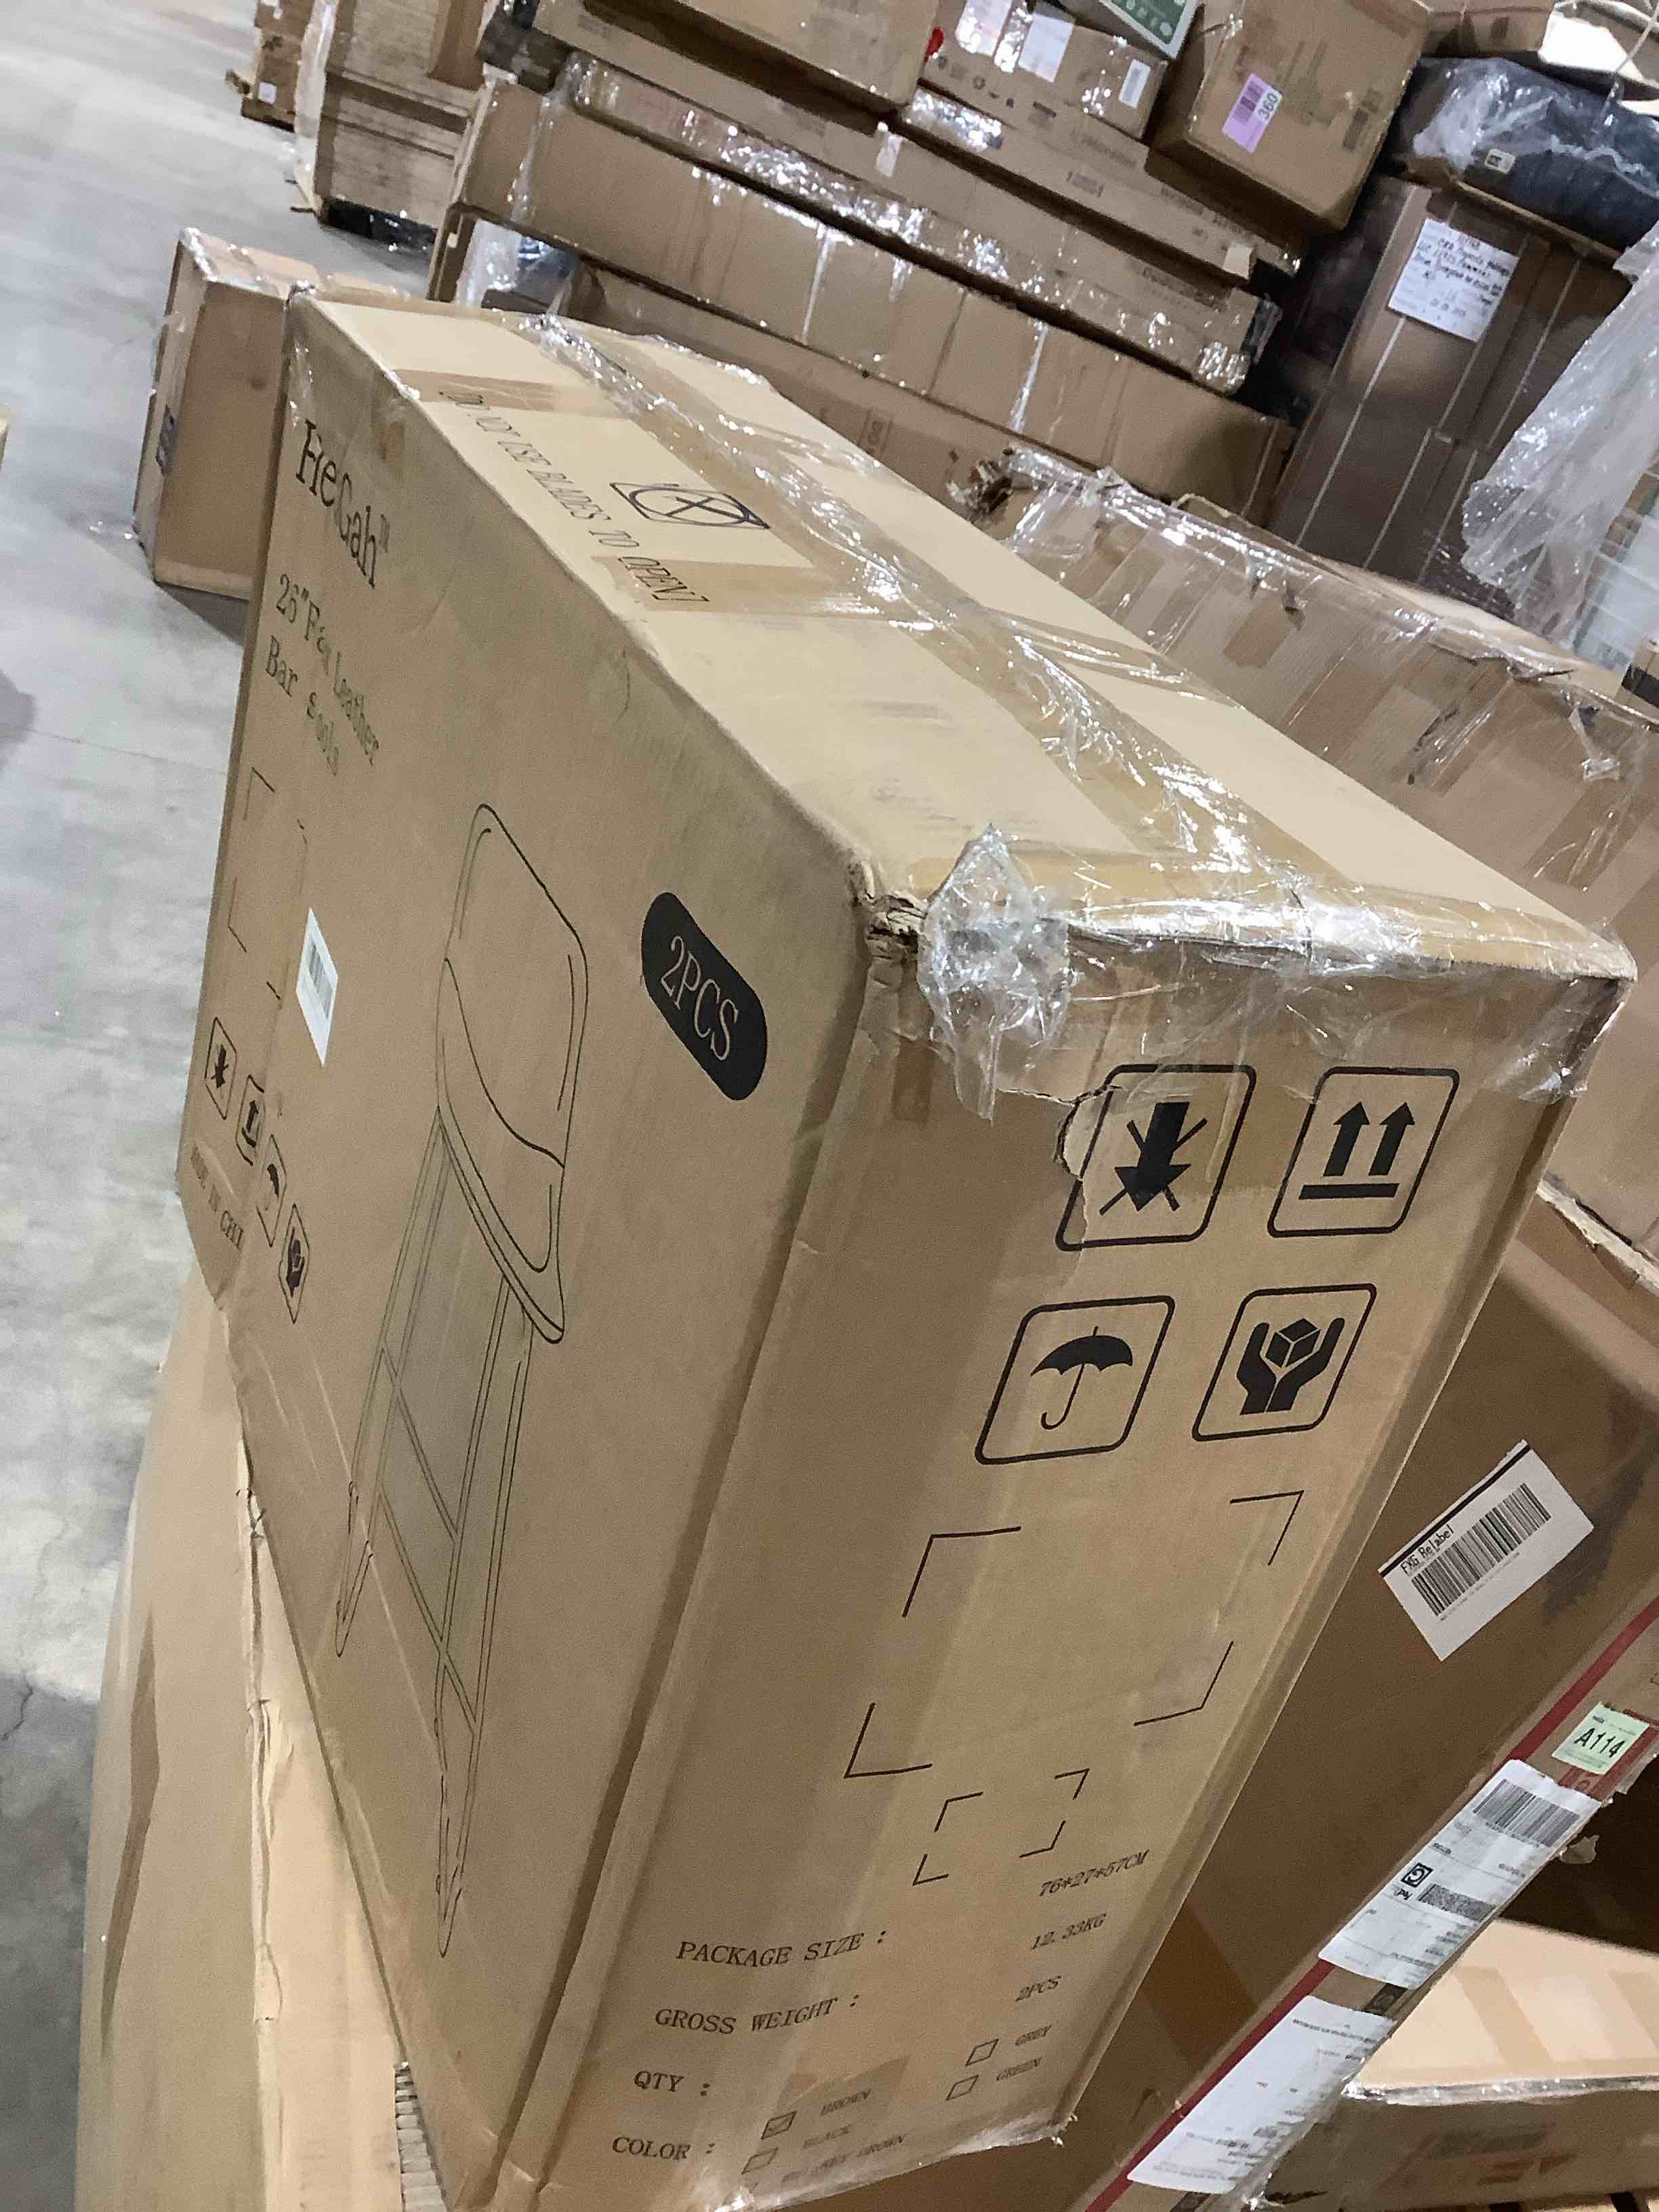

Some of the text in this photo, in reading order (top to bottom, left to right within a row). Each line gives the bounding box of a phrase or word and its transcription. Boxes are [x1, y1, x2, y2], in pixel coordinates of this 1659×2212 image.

[1258, 92, 1278, 120] 360
[497, 441, 551, 466] USE
[525, 468, 611, 520] BLADES
[588, 529, 639, 548] TO
[265, 635, 298, 698] Bar
[661, 936, 738, 1061] 2PCS
[1418, 1524, 1454, 1559] Relabel
[1574, 1727, 1626, 1758] A114
[676, 1941, 792, 1967] PACKAGE
[804, 1933, 864, 1961] SIZE
[634, 2071, 684, 2092] QTY
[1016, 1975, 1061, 2002] 2PCS
[655, 2009, 737, 2034] GROSS
[752, 1997, 838, 2031] WEIGHT
[613, 2137, 691, 2160] COLOR
